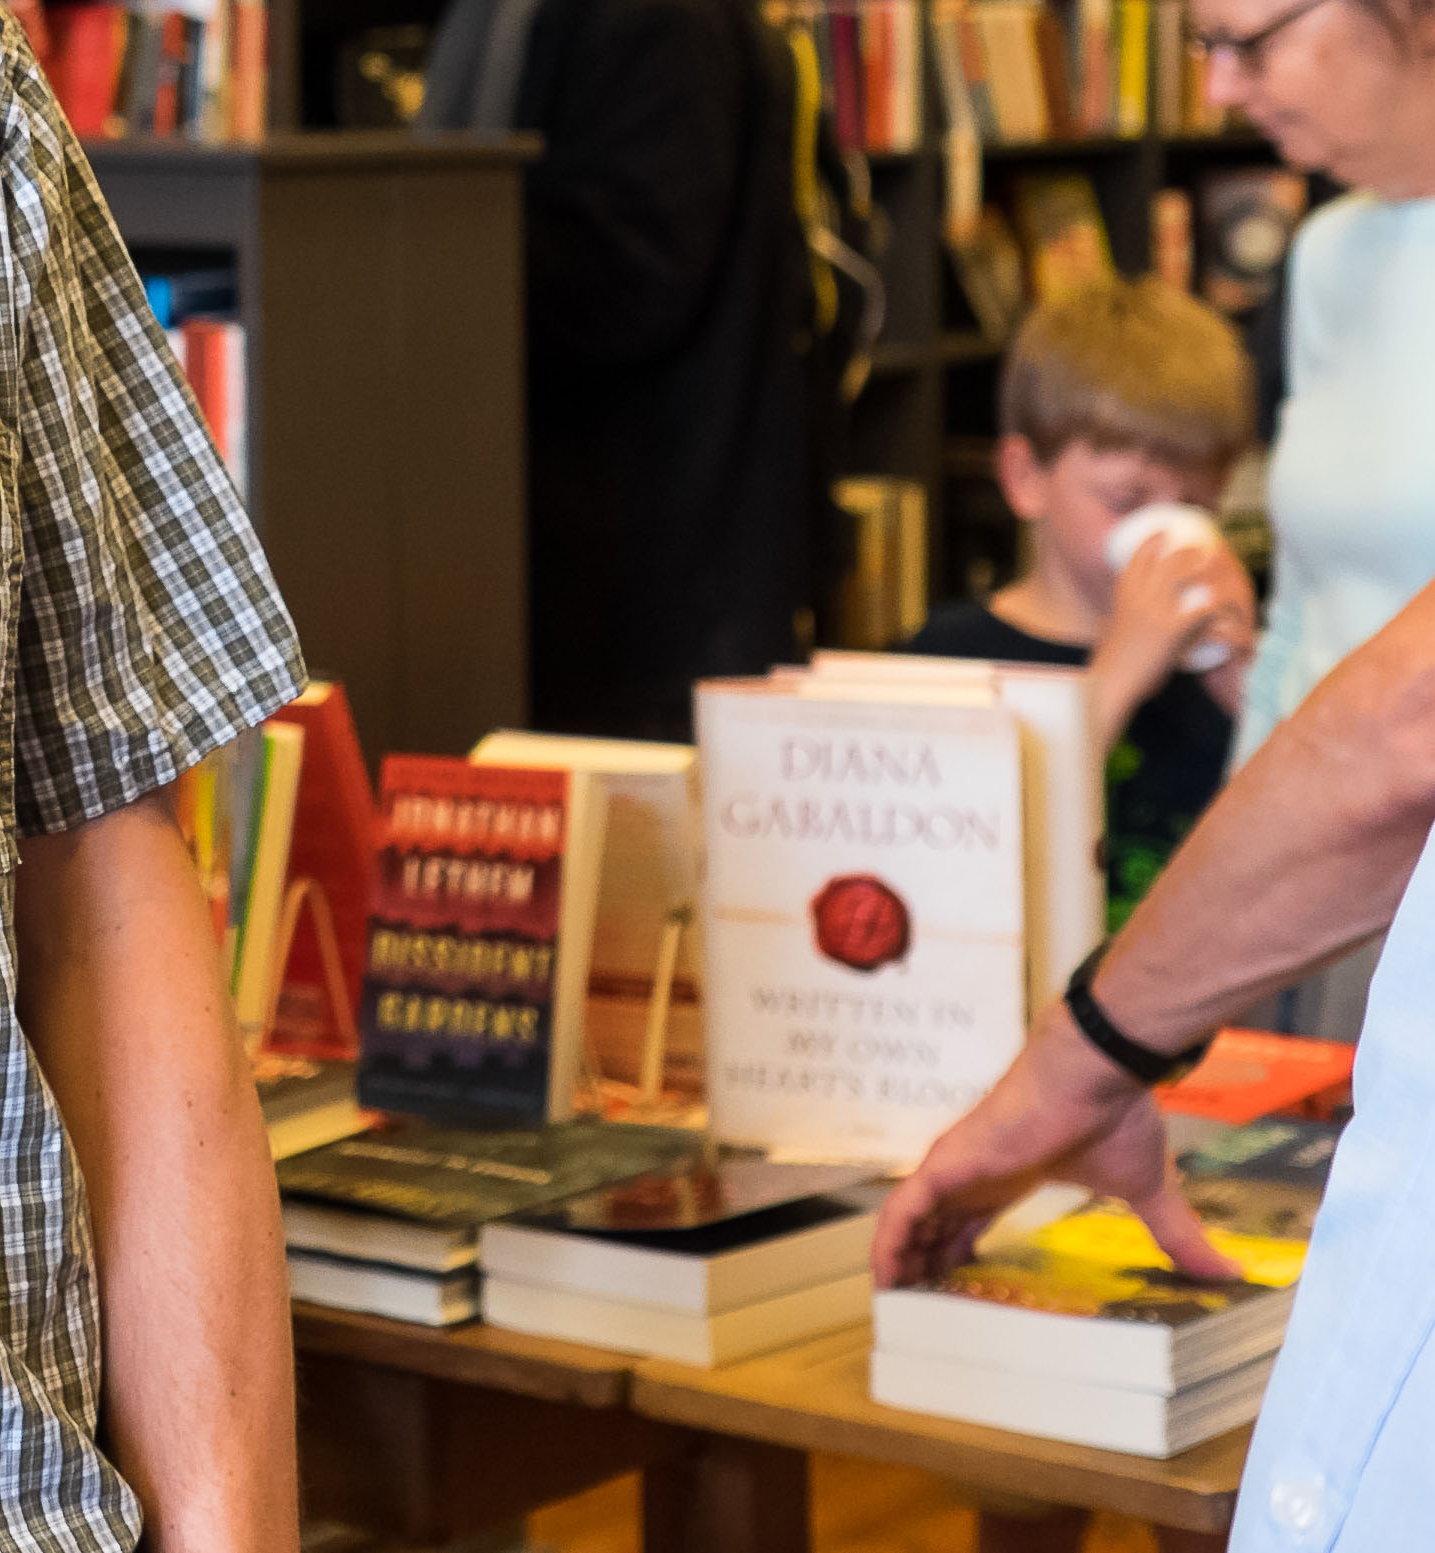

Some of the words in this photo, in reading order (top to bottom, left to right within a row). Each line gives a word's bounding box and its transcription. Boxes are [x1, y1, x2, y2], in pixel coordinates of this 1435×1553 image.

[780, 735, 943, 789] DIANA
[720, 793, 1001, 854] GABALDON
[749, 987, 920, 1028] WRITTEN
[847, 1033, 941, 1068] OWN
[879, 1076, 987, 1108] BLOO
